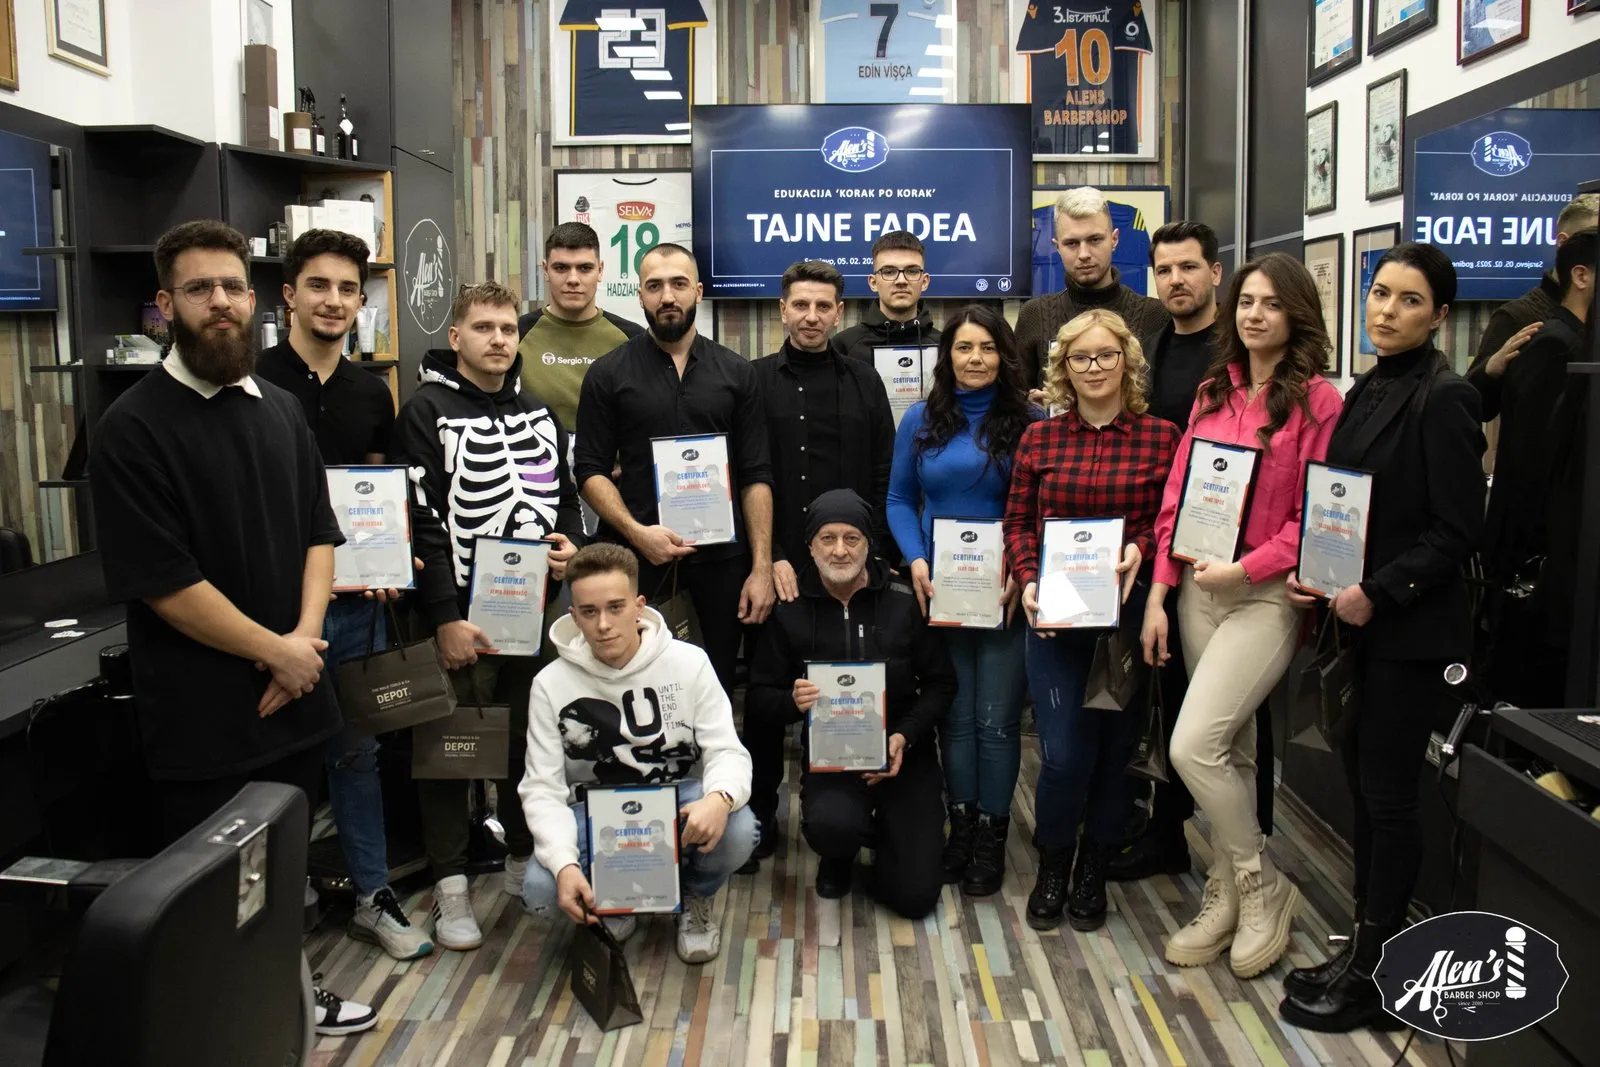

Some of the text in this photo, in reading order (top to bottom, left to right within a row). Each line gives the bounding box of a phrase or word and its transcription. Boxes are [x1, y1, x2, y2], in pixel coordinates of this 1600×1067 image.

[869, 2, 899, 59] 7
[1055, 28, 1112, 87] 10
[1065, 89, 1106, 106] ALENS
[1043, 109, 1128, 126] BARBERSHOP
[774, 189, 832, 198] EDUKACIJA
[878, 189, 893, 198] PO
[746, 213, 977, 243] TAJNE FADEA
[557, 357, 583, 365] Sergio
[657, 683, 685, 693] UNTIL
[660, 693, 676, 702] THE
[661, 703, 678, 712] END
[662, 712, 673, 721] OF
[665, 719, 686, 730] TIME
